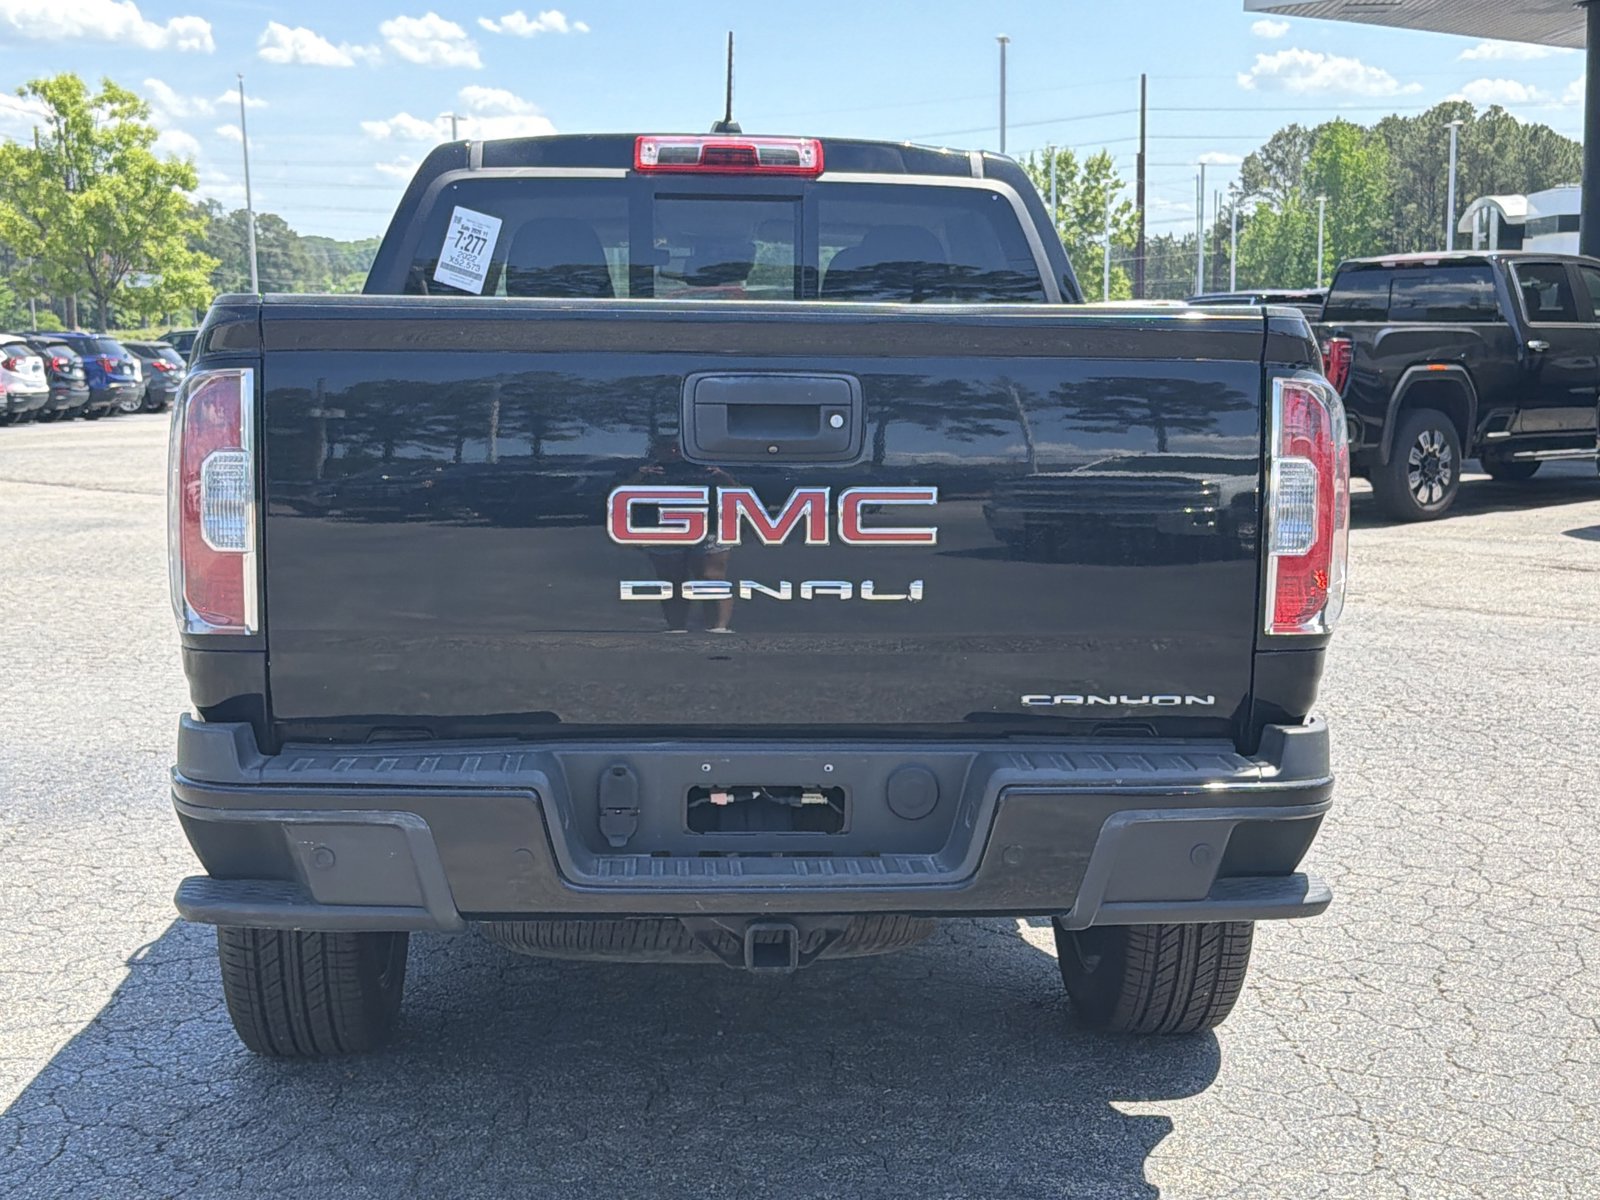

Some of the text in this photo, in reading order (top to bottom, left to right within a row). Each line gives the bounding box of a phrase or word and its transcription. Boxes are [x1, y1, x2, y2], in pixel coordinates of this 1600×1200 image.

[454, 230, 488, 256] 7:277
[457, 250, 478, 263] 2022
[606, 485, 938, 546] GMC
[619, 579, 924, 602] DENALI
[1020, 694, 1216, 706] CANYON
